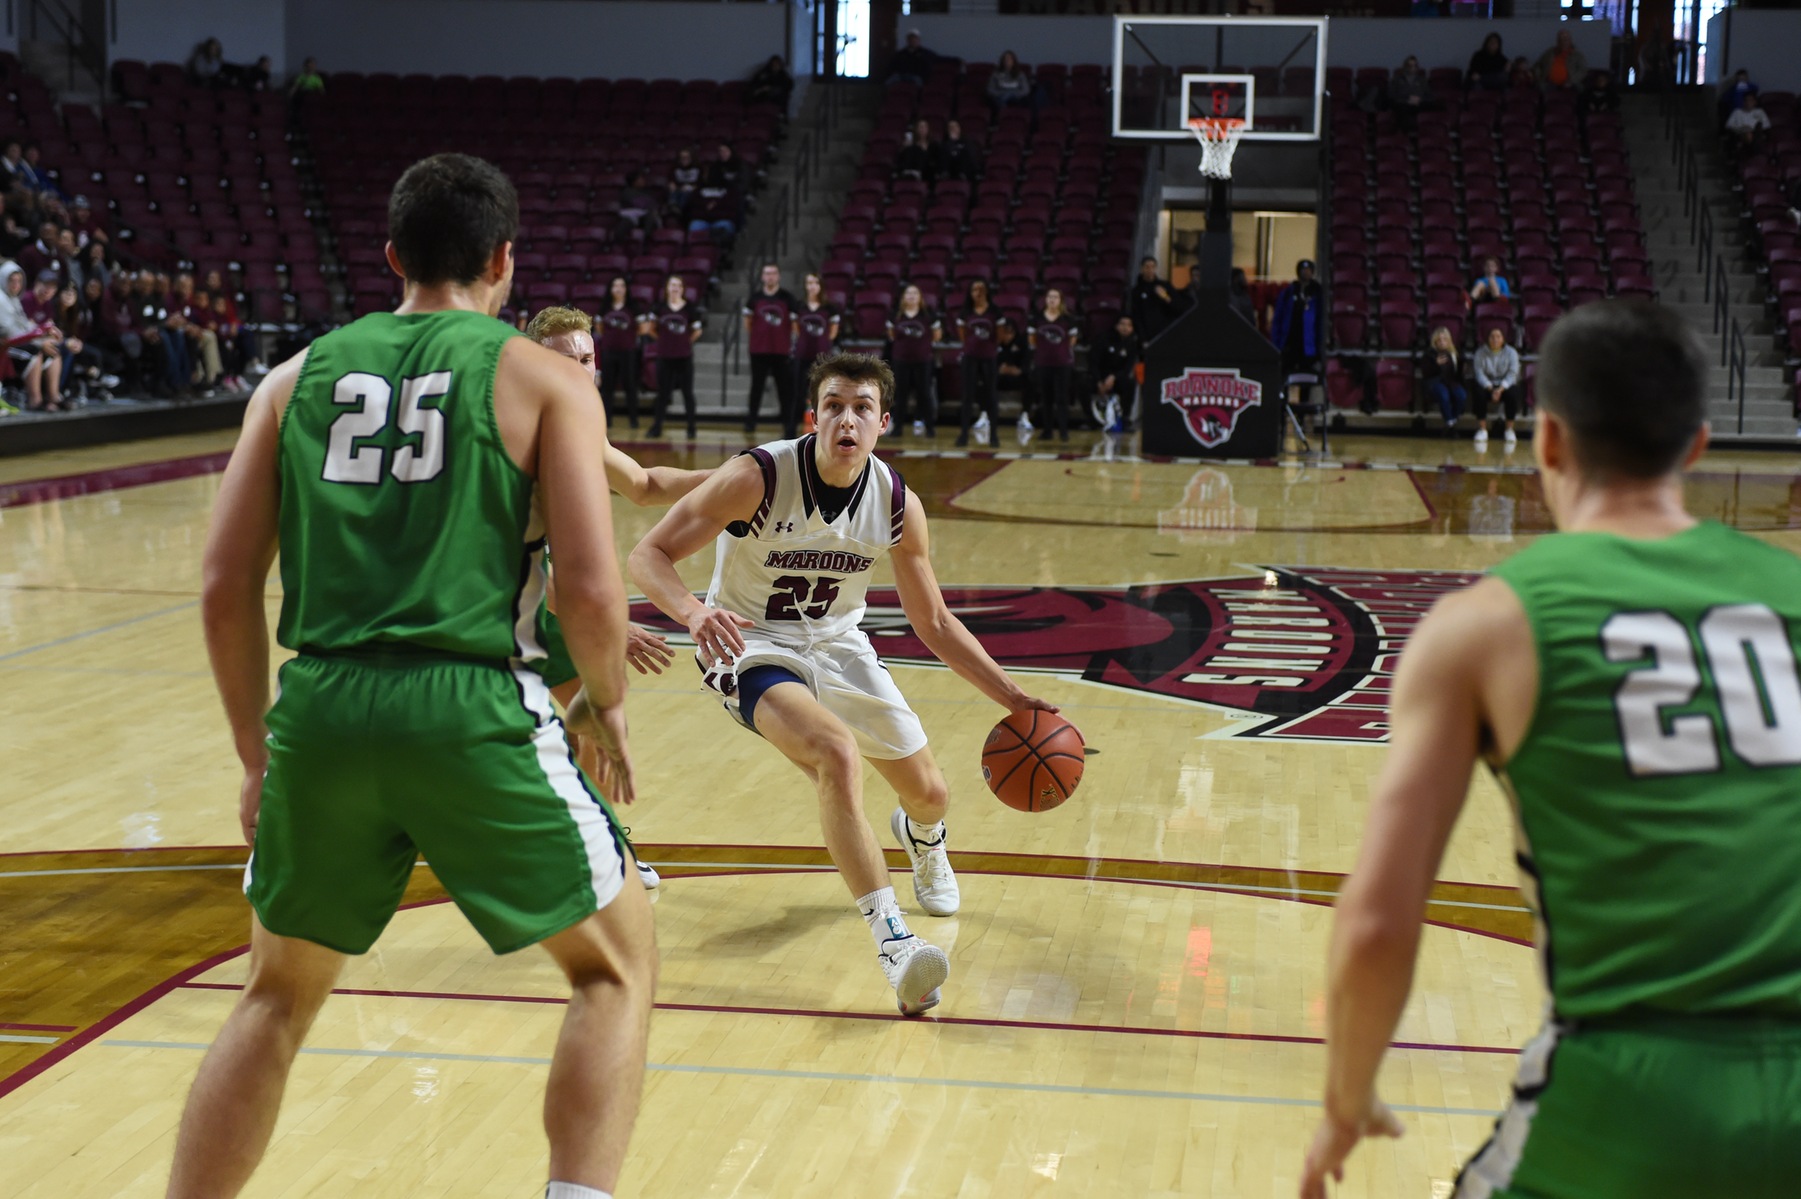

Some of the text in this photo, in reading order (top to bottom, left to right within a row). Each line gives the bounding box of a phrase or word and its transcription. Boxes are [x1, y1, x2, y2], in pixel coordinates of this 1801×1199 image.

[1165, 376, 1259, 401] ROANOKE
[320, 368, 453, 486] 25
[764, 550, 875, 574] MAROONS
[765, 575, 846, 621] 25
[1179, 587, 1338, 689] MAROONS
[1597, 602, 1801, 780] 20
